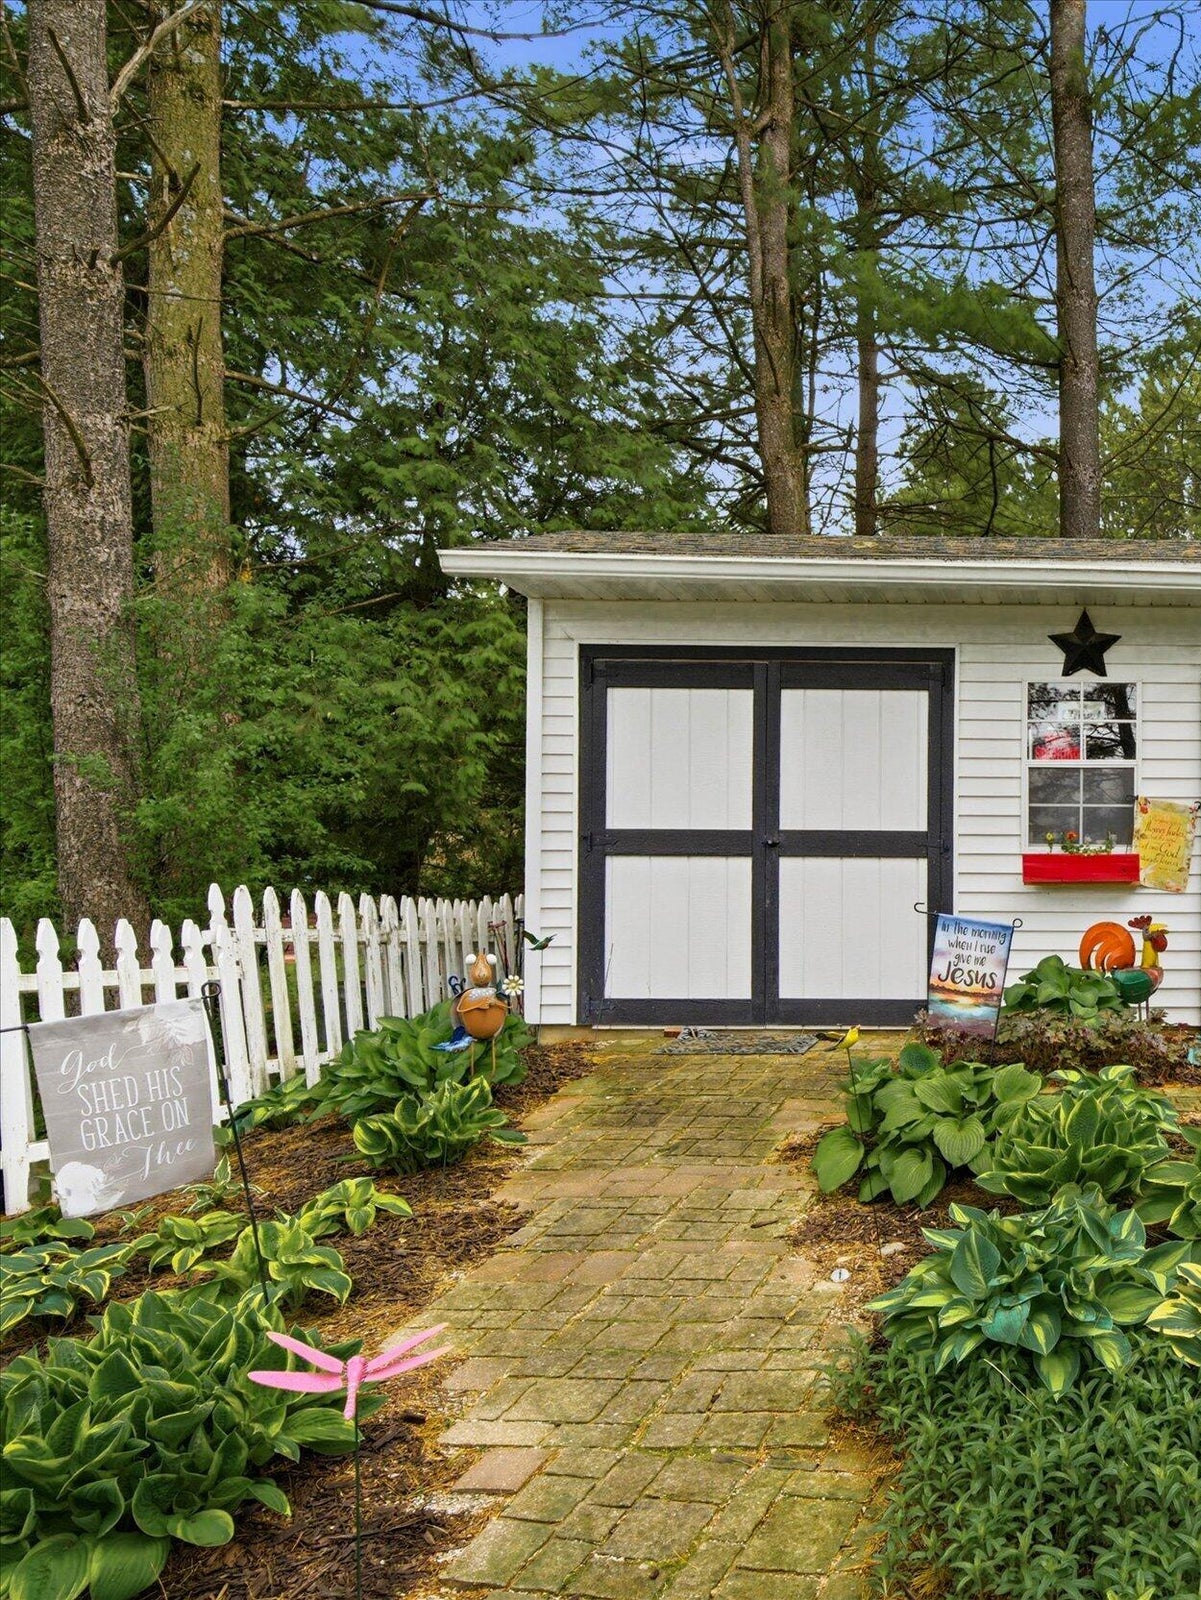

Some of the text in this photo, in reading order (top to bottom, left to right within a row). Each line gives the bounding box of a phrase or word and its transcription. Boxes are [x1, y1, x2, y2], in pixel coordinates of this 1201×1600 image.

[948, 937, 972, 950] when
[980, 943, 996, 954] rise
[971, 929, 1006, 944] morning
[938, 961, 998, 989] Jesus
[953, 953, 987, 966] give me
[57, 1042, 122, 1095] God
[77, 1066, 184, 1117] SHED HIS
[80, 1097, 192, 1152] GRACE ON
[123, 1137, 197, 1182] Thee
